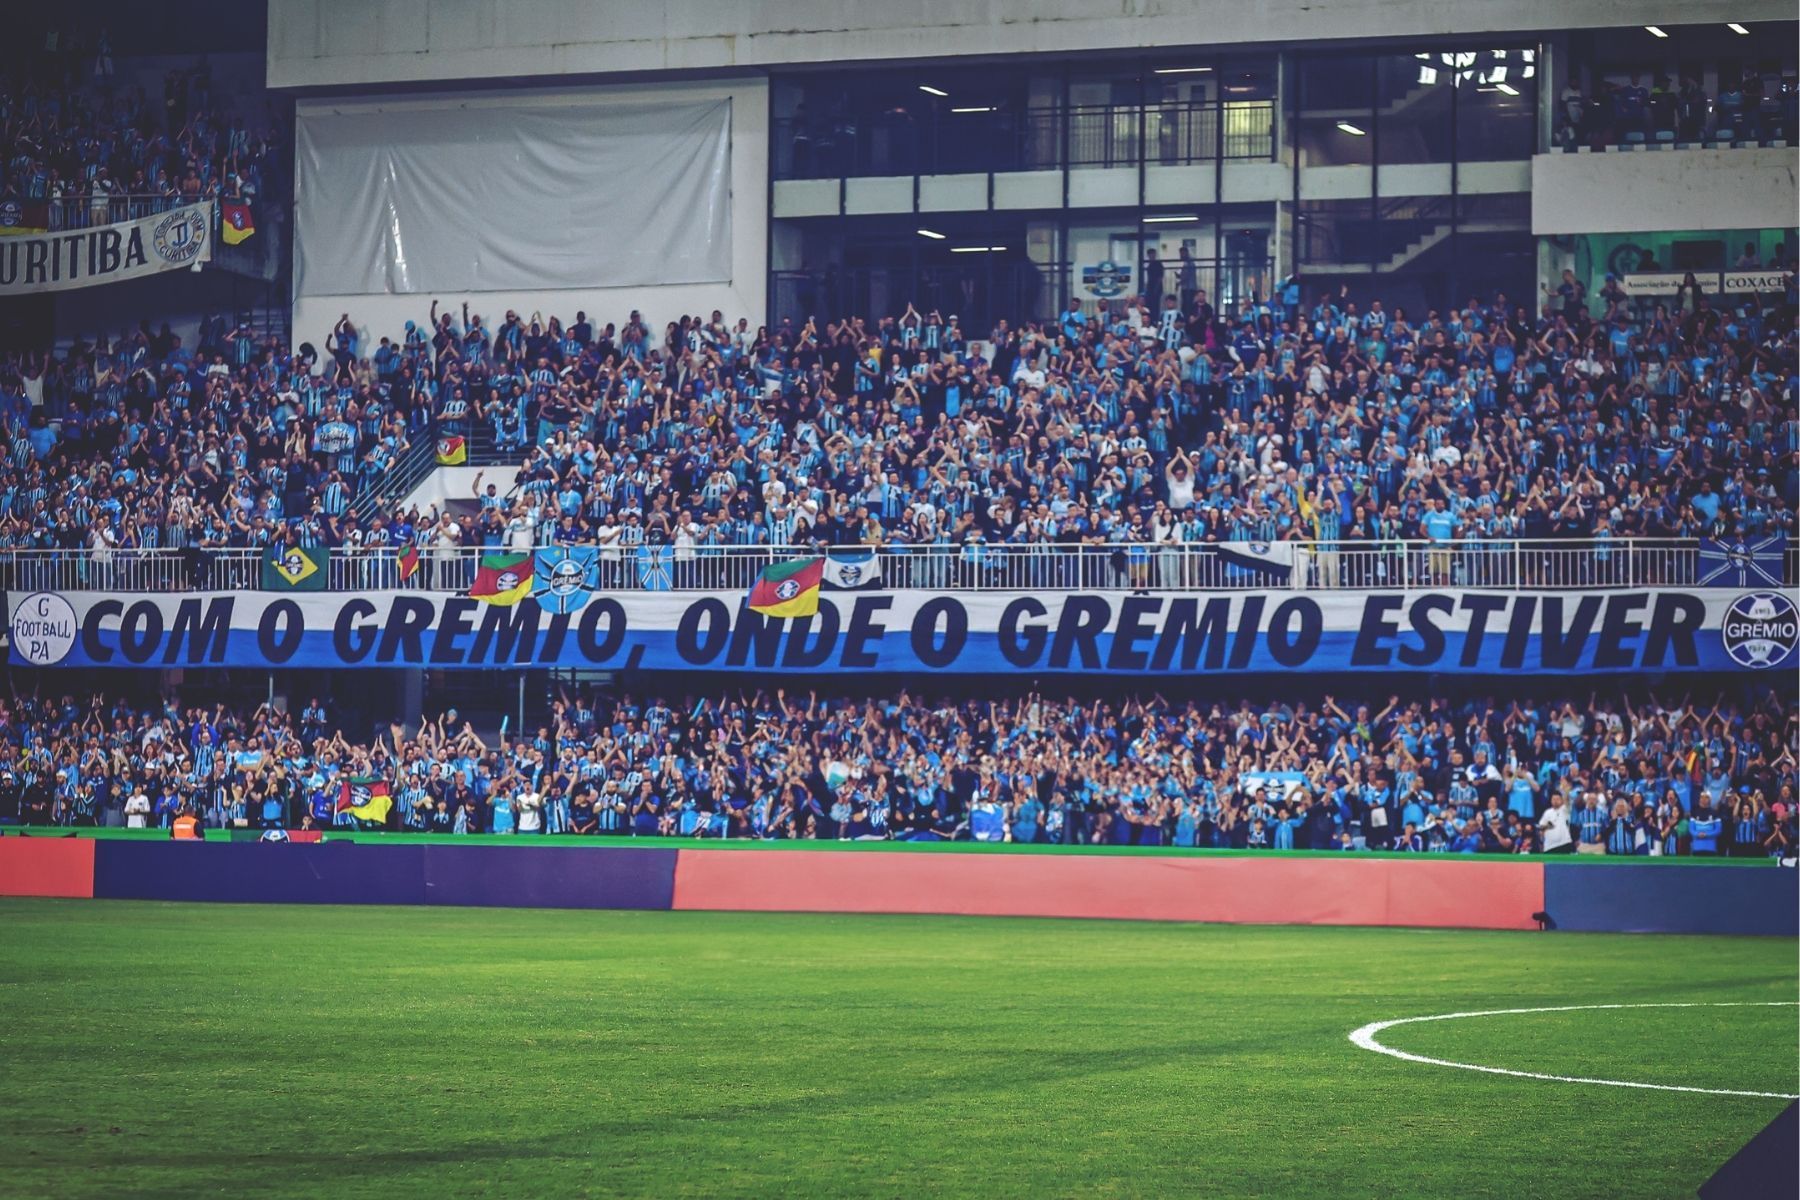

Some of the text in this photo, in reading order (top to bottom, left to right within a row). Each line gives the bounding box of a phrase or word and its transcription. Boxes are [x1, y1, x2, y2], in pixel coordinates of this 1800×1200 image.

[38, 597, 50, 617] G
[16, 618, 71, 639] FOOTBALL
[81, 590, 1706, 670] COM O GRÊMIO, ONDE O GRÊMIO ESTIVER
[1727, 619, 1796, 638] GRÊMIO
[29, 640, 50, 661] PA
